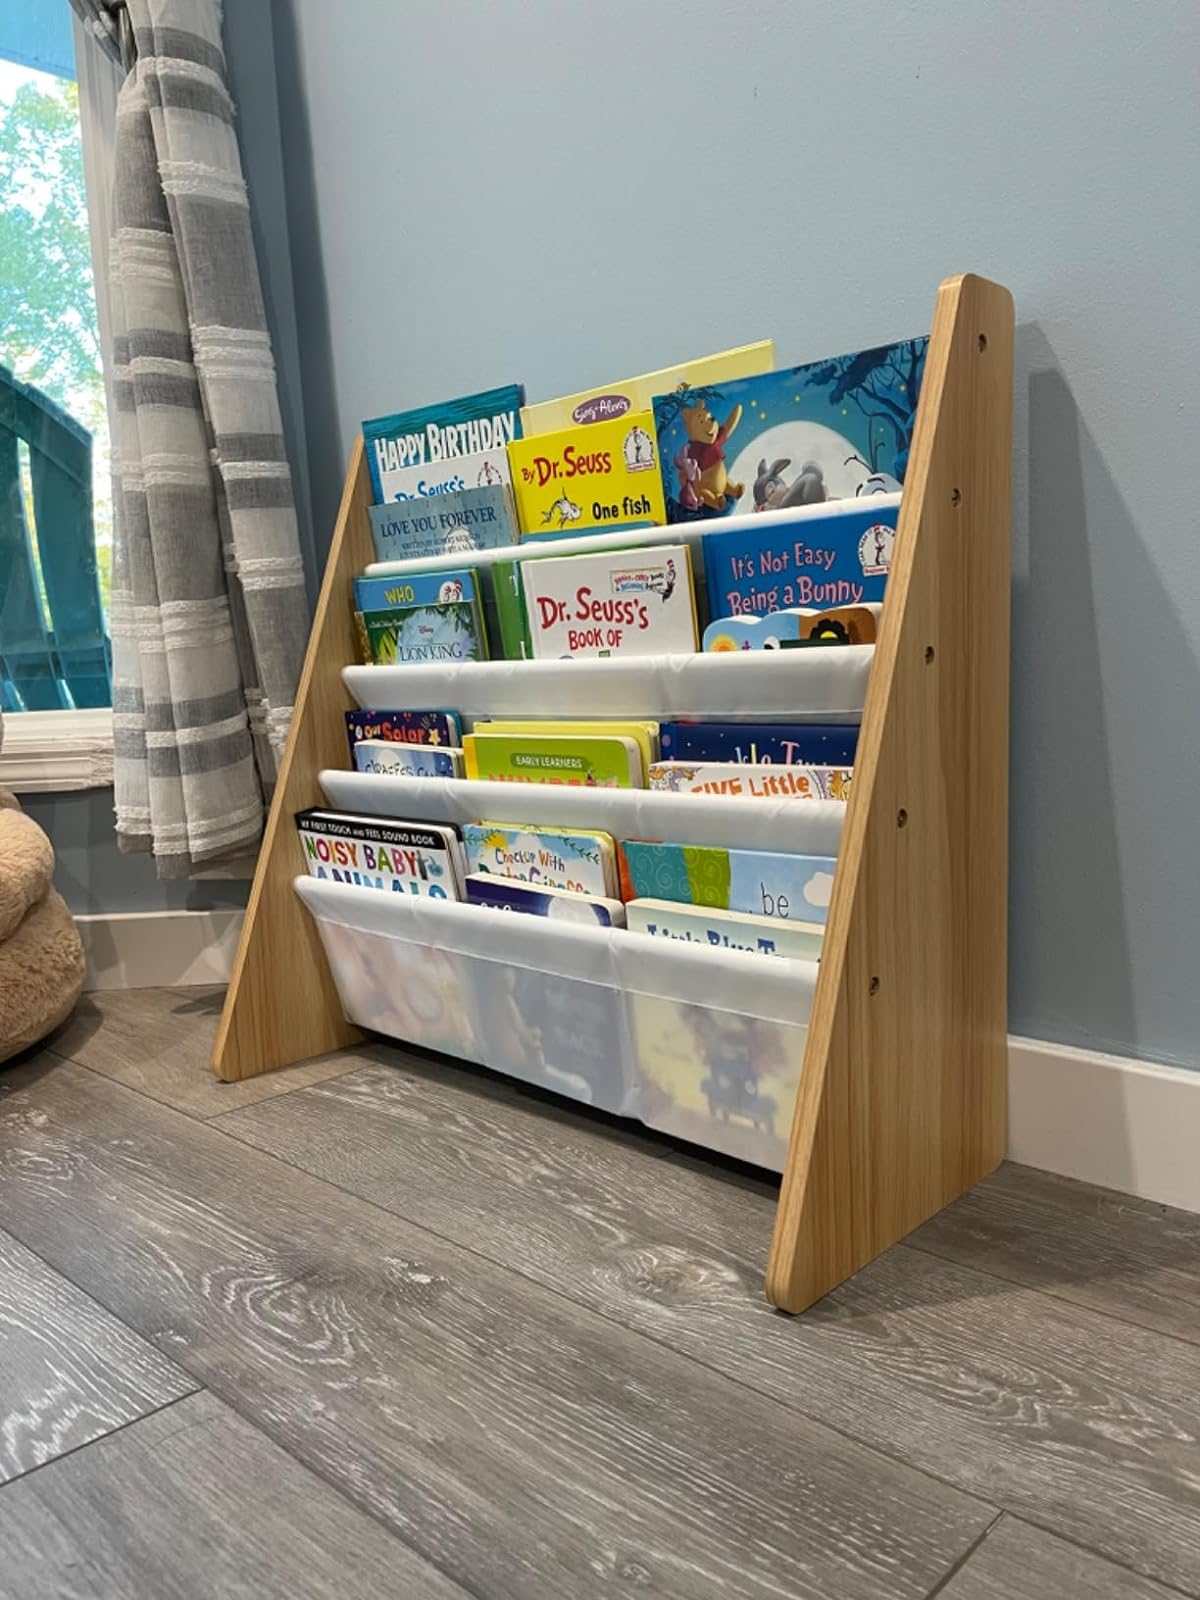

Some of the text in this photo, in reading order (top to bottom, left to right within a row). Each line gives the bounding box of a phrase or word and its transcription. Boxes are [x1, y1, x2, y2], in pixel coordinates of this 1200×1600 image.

[574, 399, 630, 423] Sing-Along
[375, 411, 515, 473] HAPPY BIRTHDAY
[521, 467, 534, 485] By
[533, 457, 564, 487] Dr.
[563, 446, 612, 477] Seuss
[592, 494, 651, 520] One fish
[380, 506, 497, 538] LOVE YOU FOREVER
[731, 555, 754, 581] It's
[760, 550, 790, 575] Not
[794, 543, 837, 571] Easy
[385, 585, 414, 604] WHO
[727, 575, 864, 616] Being a Bunny
[537, 597, 571, 629] Dr.
[576, 587, 649, 629] Seuss's
[568, 628, 623, 650] BOOK OF
[399, 643, 463, 662] LION KING
[382, 722, 425, 743] Solar
[516, 755, 583, 768] EARLY LEARNERS
[749, 772, 809, 797] Little
[311, 821, 328, 832] FIRST
[328, 823, 352, 836] TOUCH
[365, 829, 381, 840] FEEL
[382, 831, 410, 843] SOUND
[411, 834, 435, 846] BOOK
[304, 836, 416, 877] NOISY BABY
[537, 849, 566, 873] With
[760, 881, 790, 918] be
